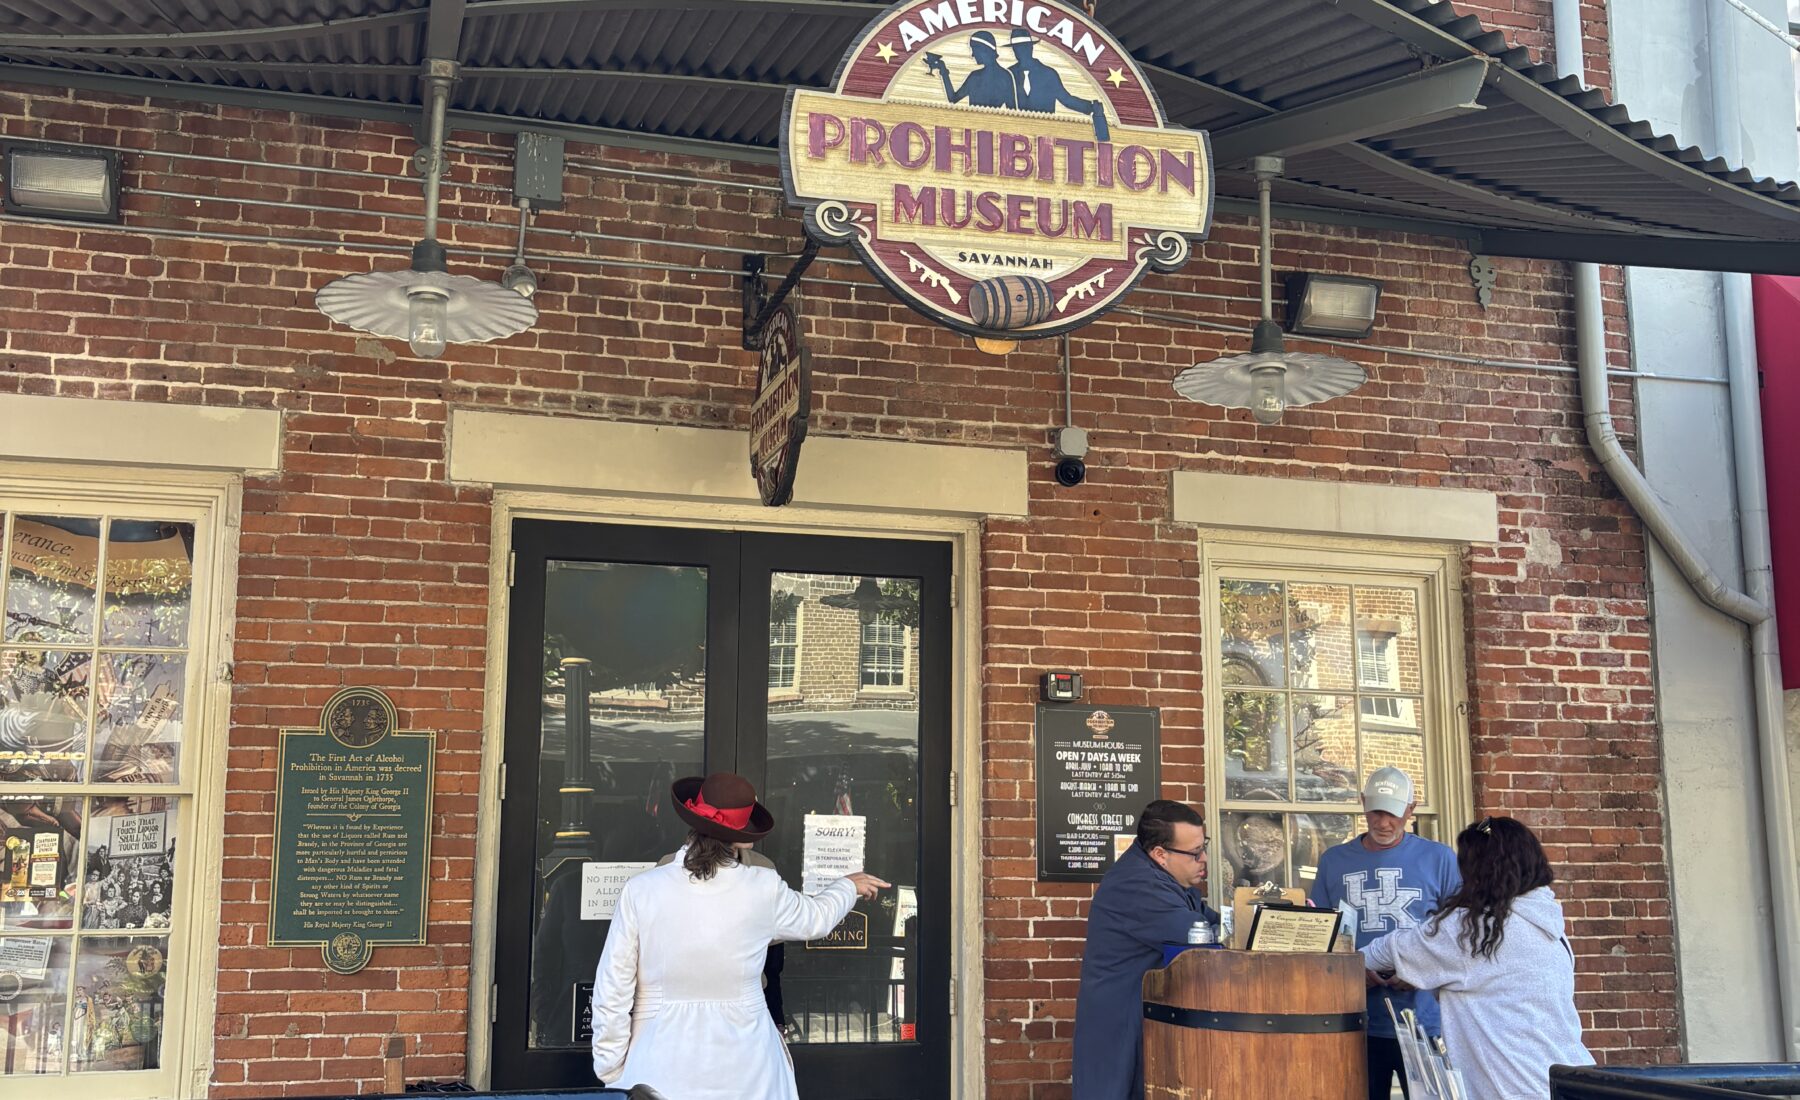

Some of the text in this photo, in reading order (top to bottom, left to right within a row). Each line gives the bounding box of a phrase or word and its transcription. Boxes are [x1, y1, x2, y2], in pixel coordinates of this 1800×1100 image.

[898, 0, 1105, 65] AMERICAN
[806, 111, 1197, 196] PROHIBITION
[892, 183, 1114, 242] MUSEUM
[958, 250, 1054, 270] SAVANNAH
[752, 368, 799, 434] PROHIBITION
[759, 415, 788, 459] MUSEUM
[12, 532, 74, 557] erance:
[1073, 741, 1100, 749] MUSEUM
[310, 754, 404, 762] The First Act of Alcohol
[1056, 751, 1141, 763] OPEN 7 DAYS A WEEK
[291, 763, 332, 771] Prohibition
[345, 764, 376, 772] America
[319, 773, 326, 781] in
[320, 787, 328, 795] by
[381, 788, 401, 796] George
[350, 803, 368, 811] Colony
[379, 803, 401, 811] Georgia
[1068, 813, 1134, 826] CONGRESS STREET UP
[117, 825, 159, 836] TOUCH LIQUOR
[815, 827, 855, 837] SORRY!
[119, 833, 157, 843] SHALL NOT
[119, 841, 157, 851] TOUCH OURS
[823, 930, 863, 941] OKING
